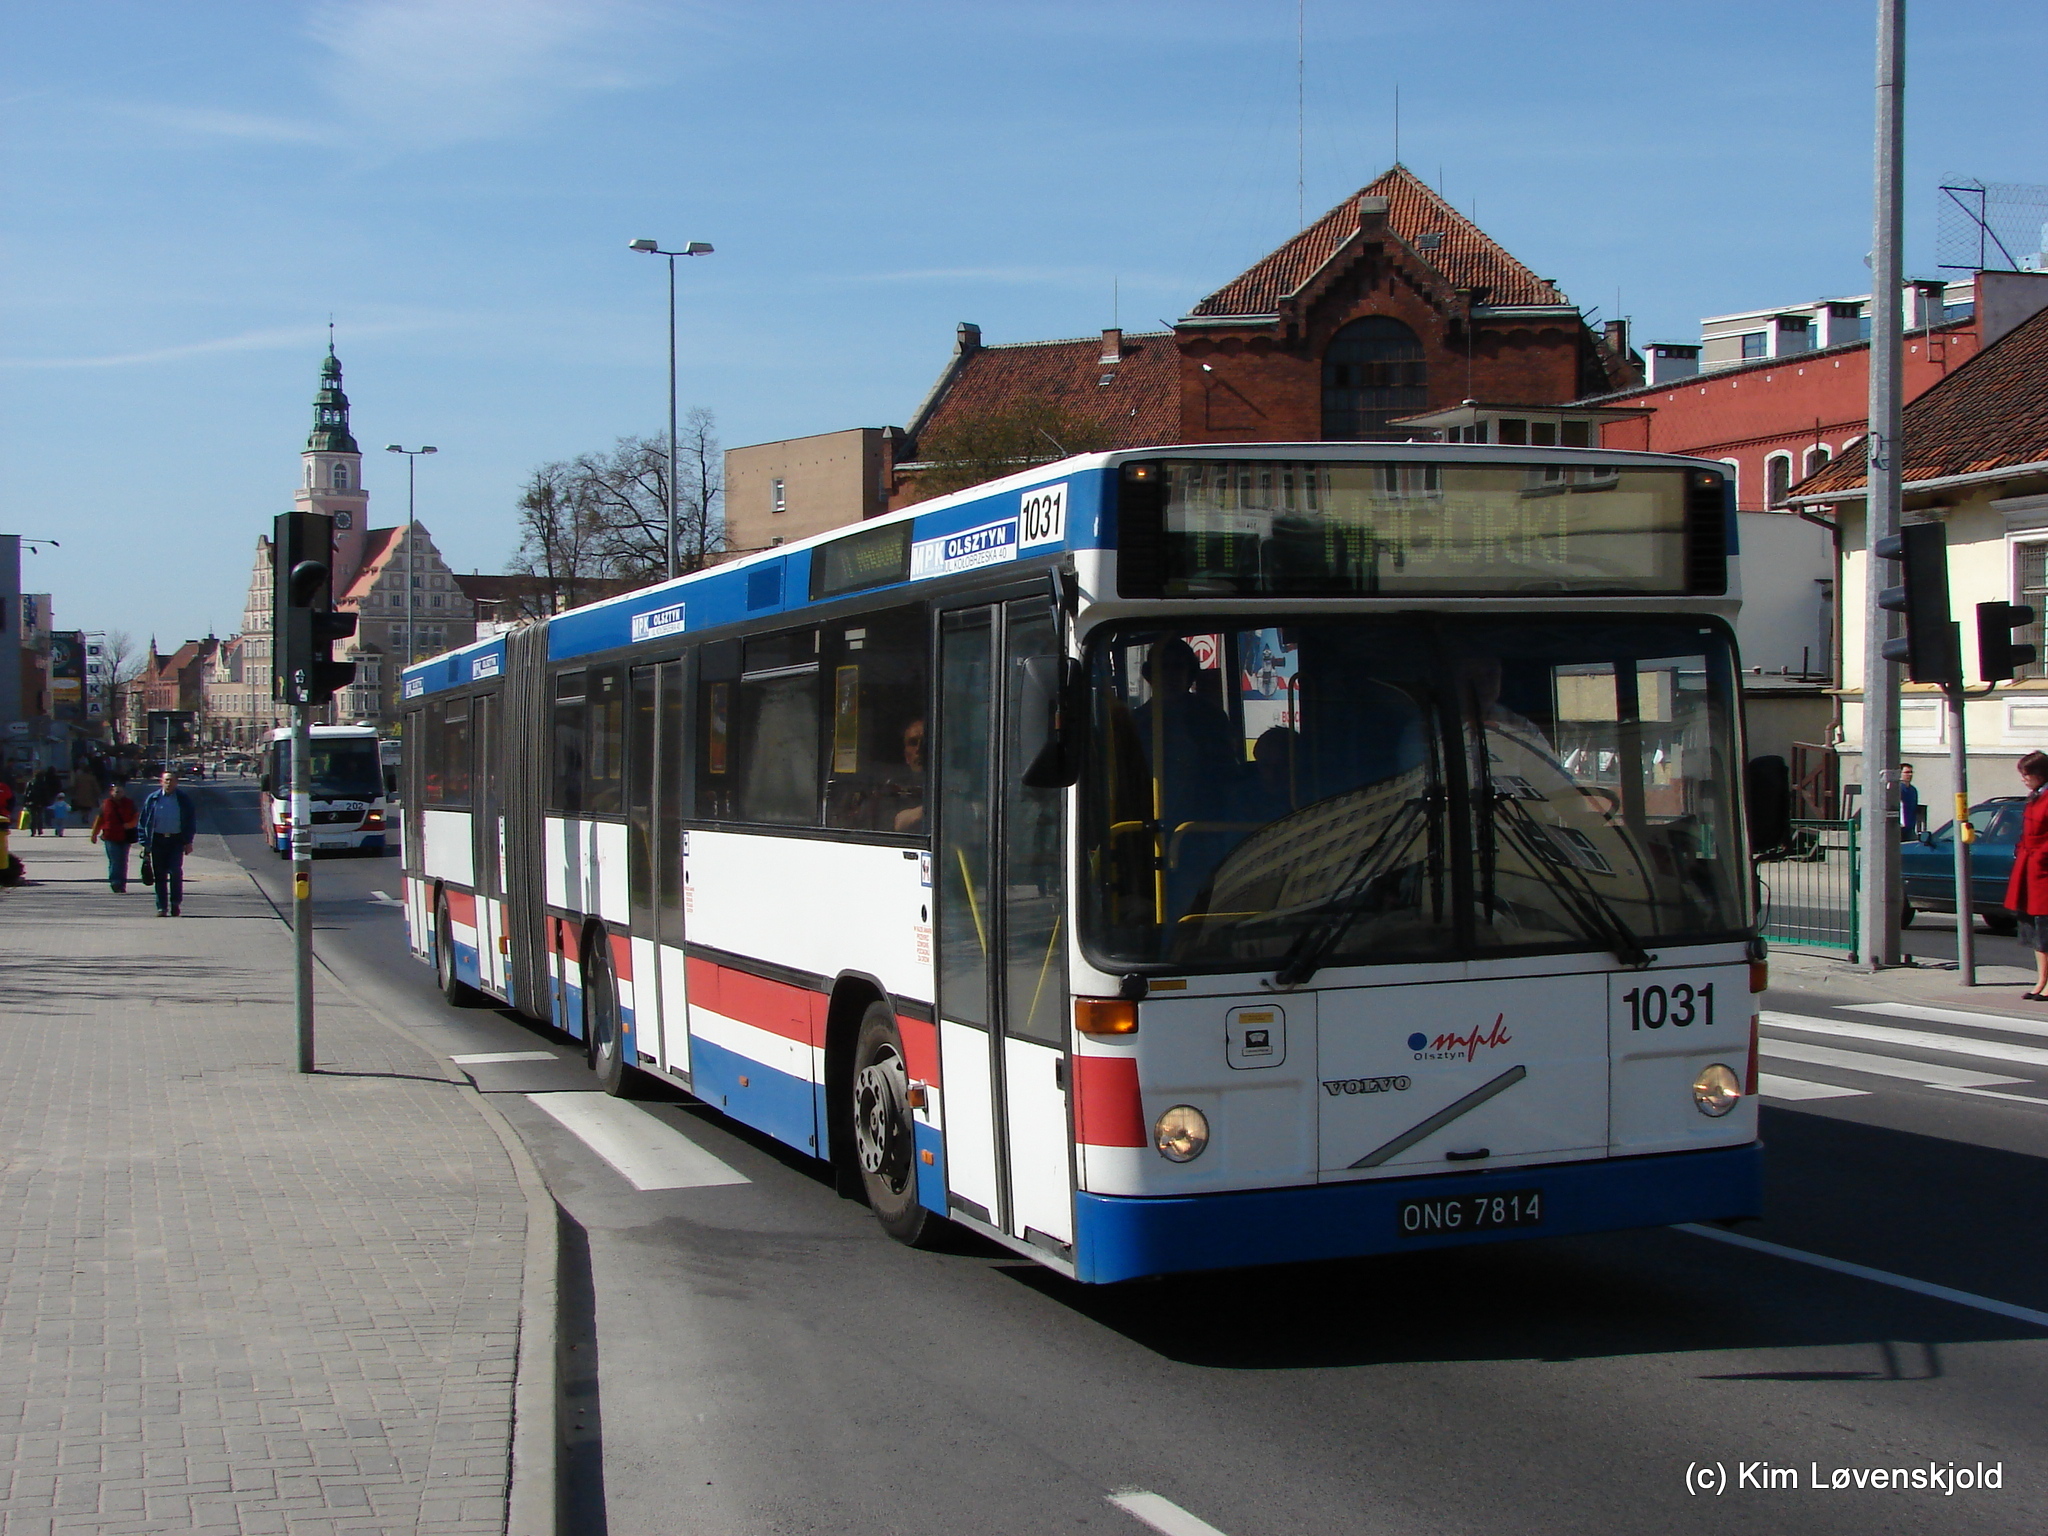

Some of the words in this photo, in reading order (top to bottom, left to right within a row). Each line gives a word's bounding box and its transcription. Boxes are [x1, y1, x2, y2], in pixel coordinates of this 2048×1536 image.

[1023, 492, 1062, 541] 1031
[911, 541, 946, 576] MPK
[948, 526, 1006, 558] OLSZTYN
[89, 646, 100, 713] DUKA
[345, 802, 364, 811] 202
[1622, 982, 1713, 1031] 1031
[1413, 1050, 1465, 1061] Olsztyn
[1429, 1012, 1513, 1063] mpk
[1323, 1074, 1411, 1096] VOLVO
[1404, 1201, 1462, 1231] ONG
[1474, 1193, 1539, 1225] 7814
